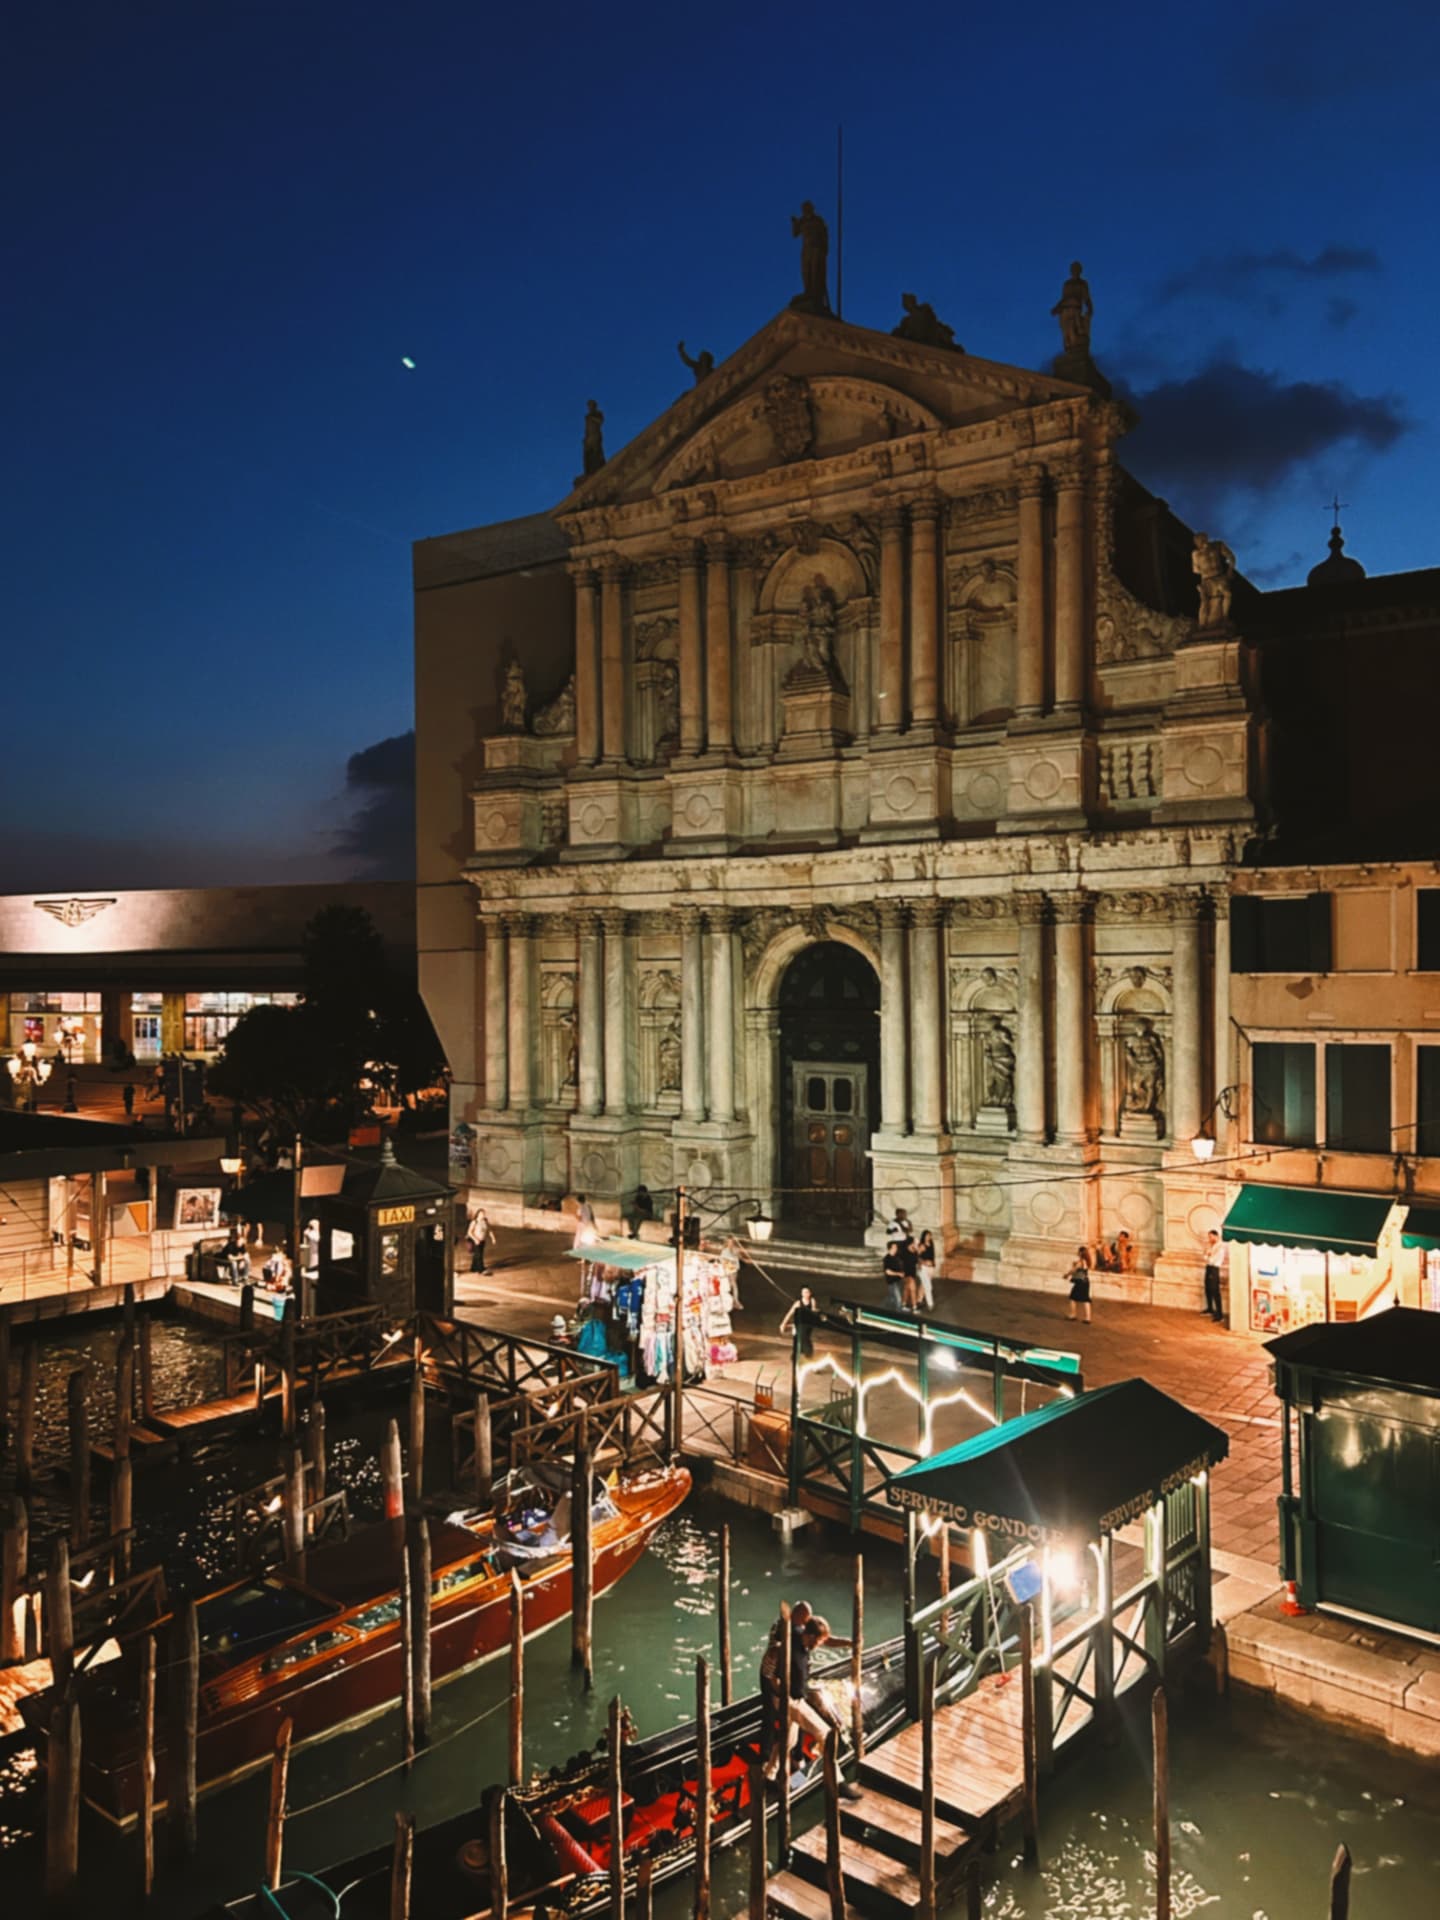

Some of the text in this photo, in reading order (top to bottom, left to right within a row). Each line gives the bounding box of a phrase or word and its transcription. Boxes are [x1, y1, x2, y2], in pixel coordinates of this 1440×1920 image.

[383, 1208, 413, 1223] TAXI
[890, 1486, 967, 1521] SERVIZIO
[1099, 1489, 1153, 1533] SERVIZIO
